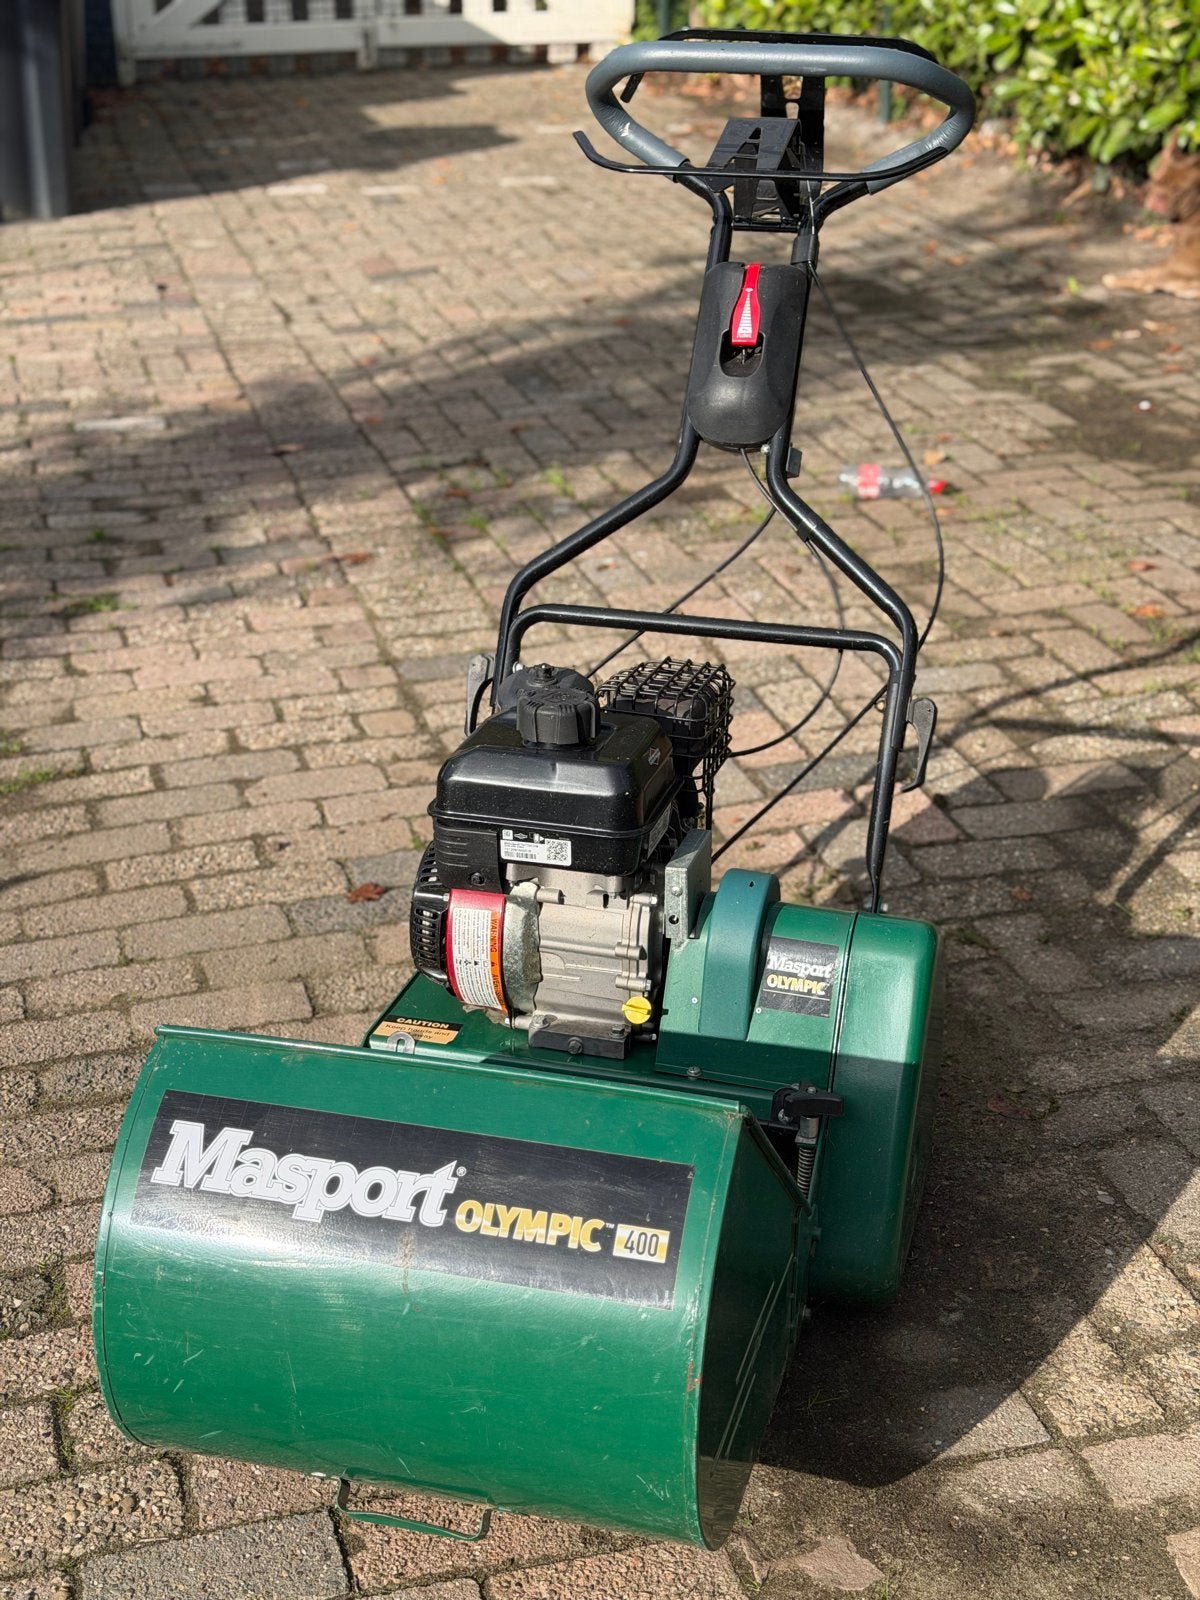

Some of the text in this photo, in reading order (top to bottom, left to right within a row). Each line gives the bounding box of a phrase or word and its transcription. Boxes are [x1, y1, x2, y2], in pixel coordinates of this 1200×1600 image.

[490, 918, 498, 953] WARNING
[767, 955, 834, 978] Masport
[766, 974, 826, 996] OLYMPIC
[396, 1017, 449, 1029] CAUTION
[150, 1120, 659, 1257] Masport OLYMPIC 400
